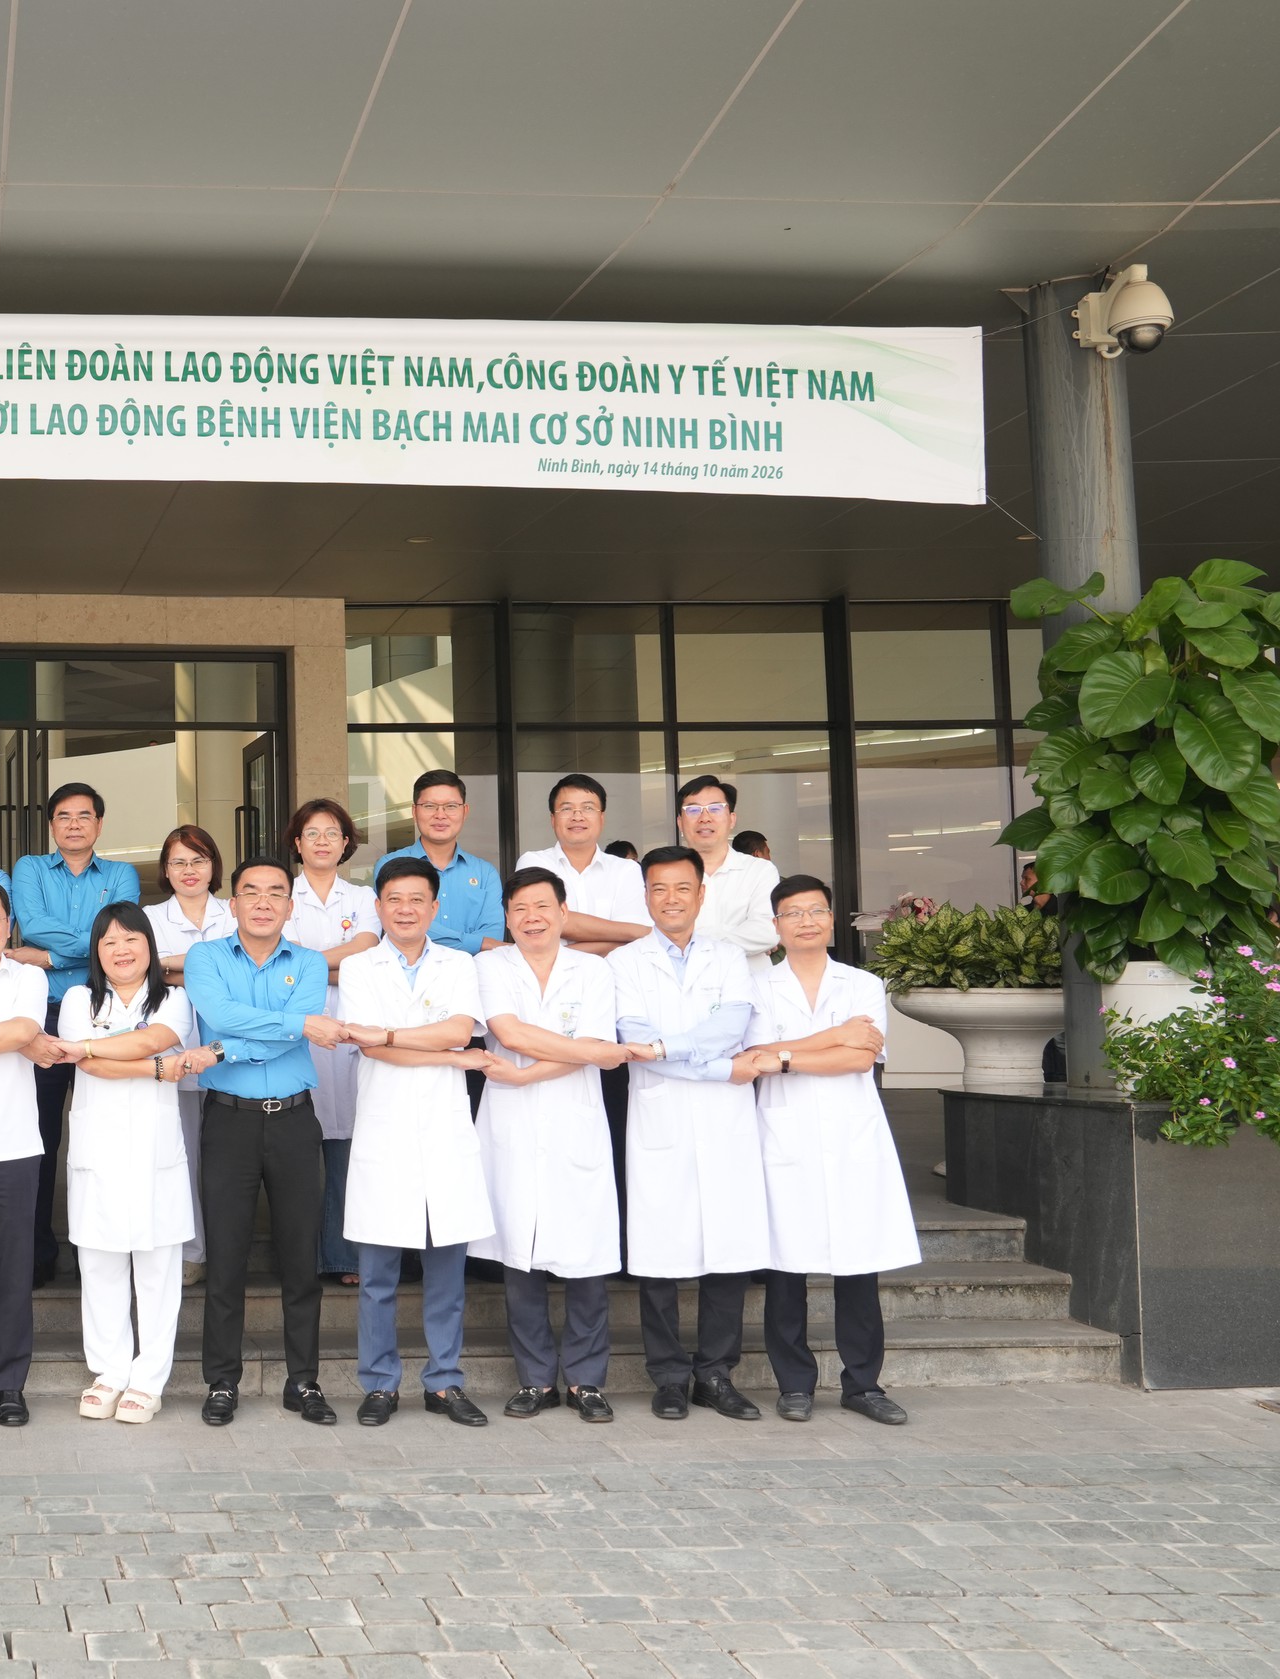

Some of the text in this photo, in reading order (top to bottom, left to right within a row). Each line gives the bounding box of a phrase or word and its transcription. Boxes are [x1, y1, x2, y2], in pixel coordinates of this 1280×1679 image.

[65, 344, 153, 382] ĐOÀN
[164, 351, 223, 383] LAO
[229, 346, 319, 393] ĐỘNG
[327, 348, 394, 394] VIỆT
[575, 356, 660, 394] ĐOÀN
[667, 364, 685, 396] Y
[691, 356, 728, 397] TẾ
[733, 362, 801, 407] VIỆT
[806, 368, 877, 402] NAM
[30, 403, 88, 436] LAO
[96, 397, 187, 445] ĐỘNG
[196, 399, 281, 447] BỆNH
[289, 401, 362, 448] VIỆN
[372, 409, 452, 449] BẠCH
[462, 411, 520, 445] MAI
[529, 412, 569, 446] CƠ
[575, 405, 614, 447] SỞ
[622, 416, 699, 449] NINH
[707, 413, 782, 452] BÌNH
[537, 458, 784, 480] Ninh Bình, ngày 14 tháng 10 năm 2026
